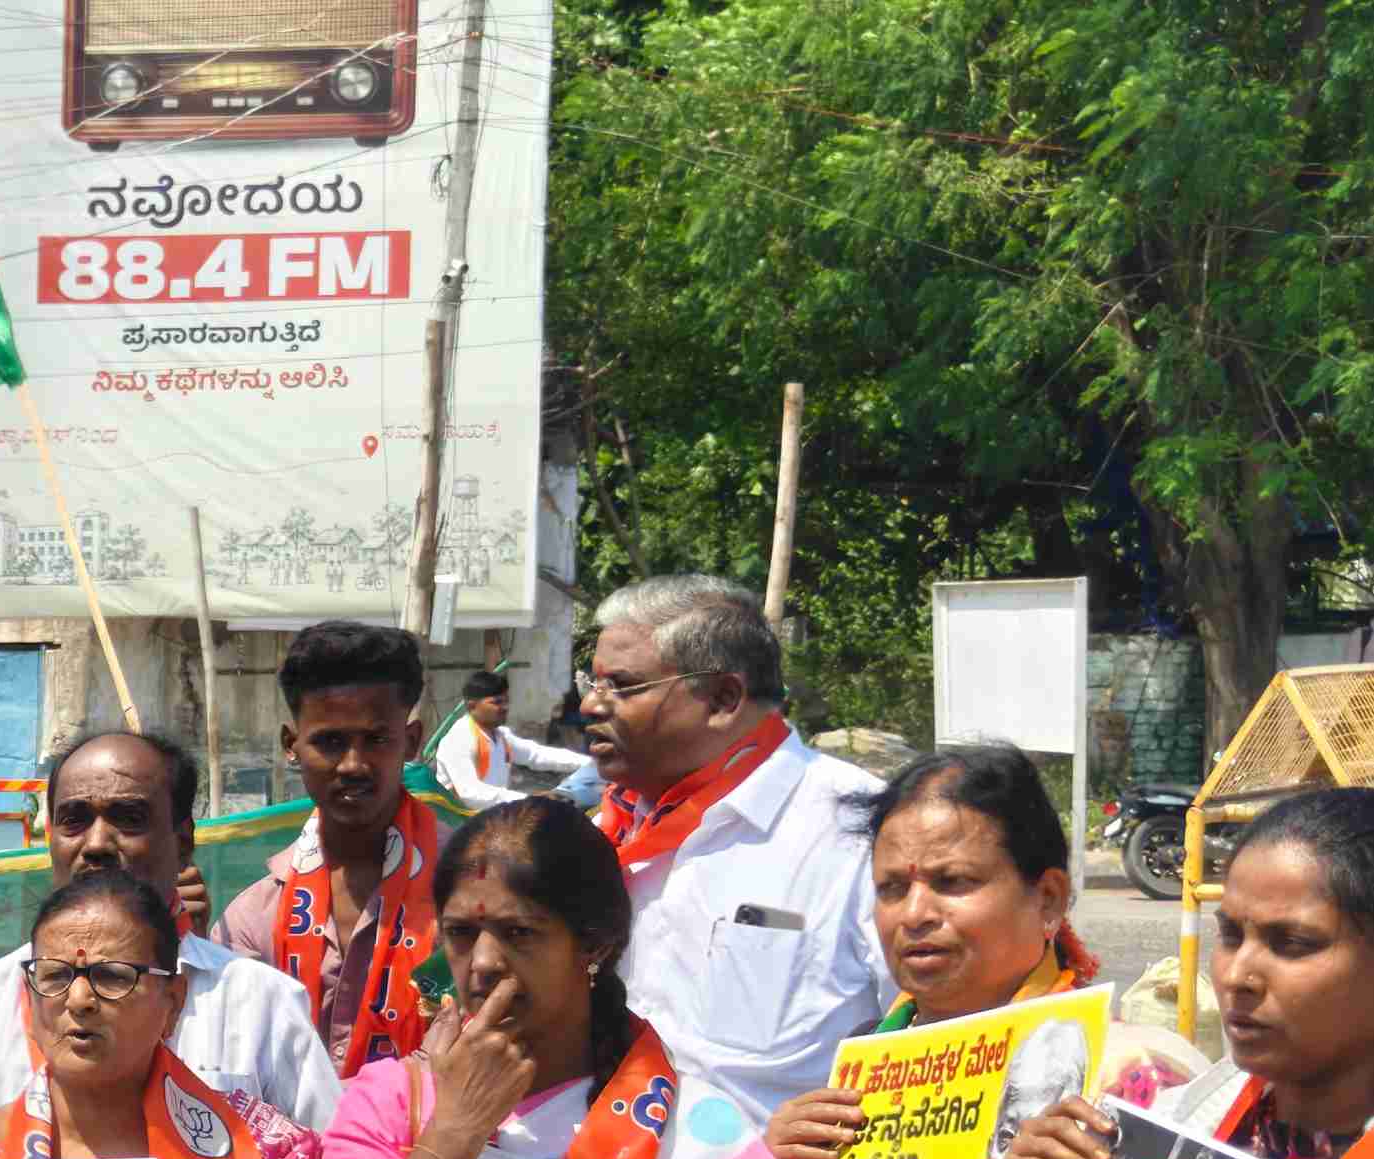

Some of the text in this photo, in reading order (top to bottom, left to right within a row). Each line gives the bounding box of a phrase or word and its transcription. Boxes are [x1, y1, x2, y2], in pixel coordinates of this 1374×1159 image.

[87, 173, 364, 226] ನವೋದಯ
[58, 234, 391, 300] 88.4 FM
[121, 319, 322, 353] ಪ್ರಸಾರವಾಗುತ್ತಿದೆ
[91, 369, 156, 402] ನಿಮ್ಮ
